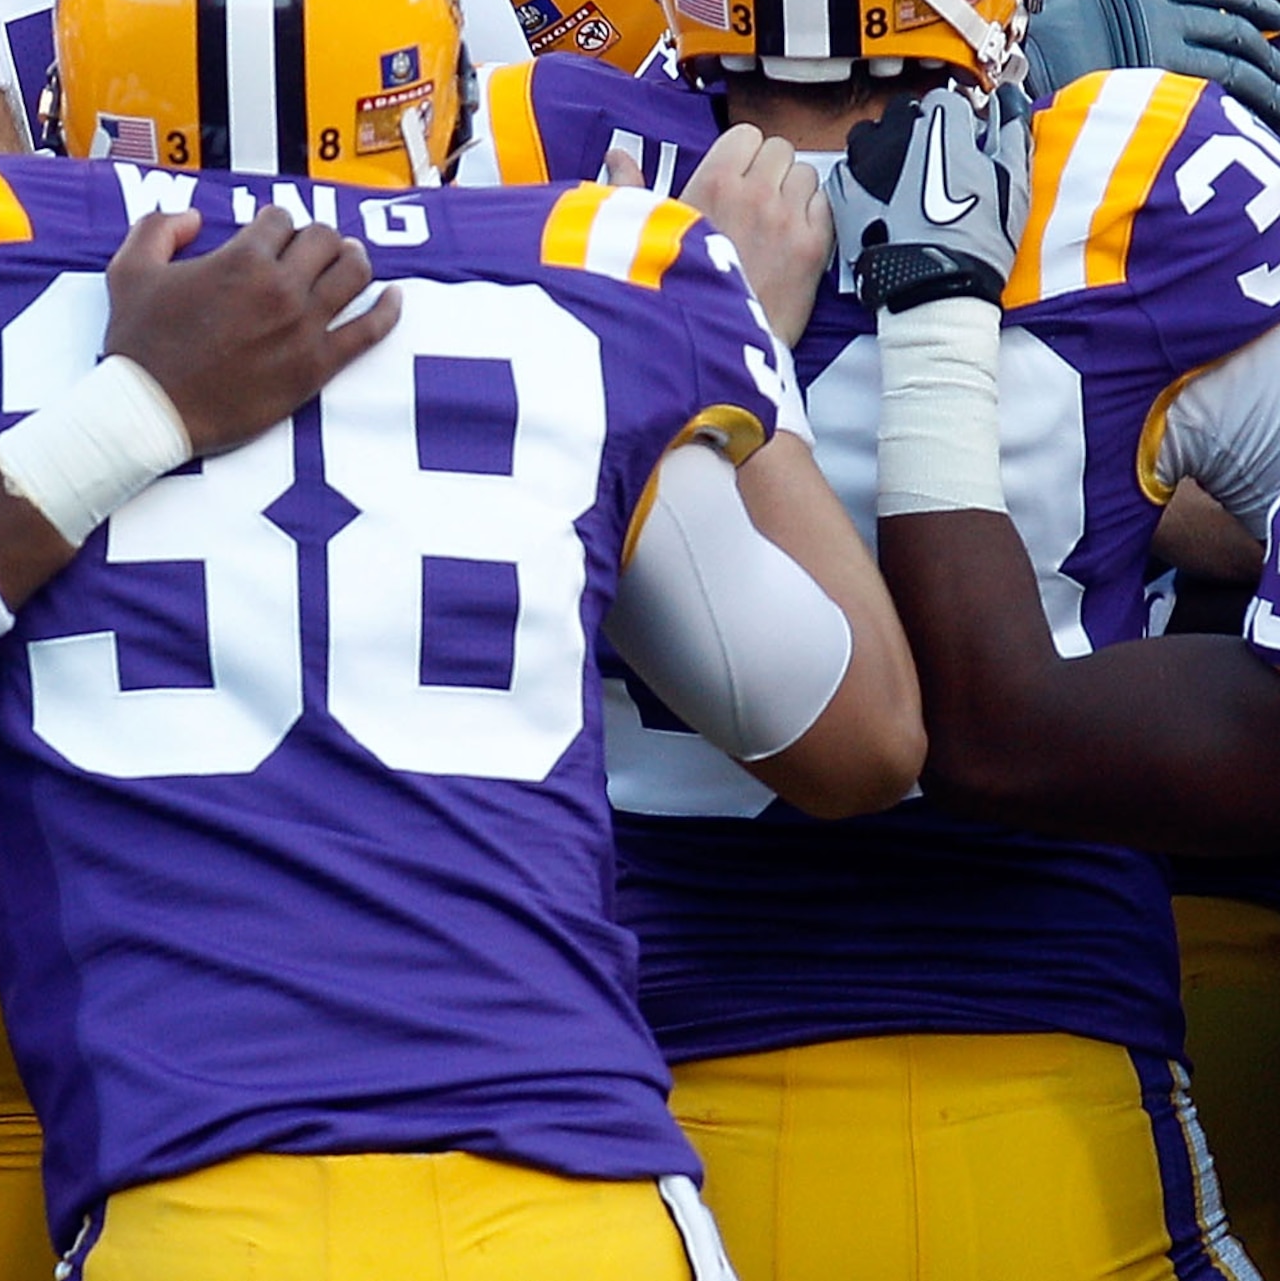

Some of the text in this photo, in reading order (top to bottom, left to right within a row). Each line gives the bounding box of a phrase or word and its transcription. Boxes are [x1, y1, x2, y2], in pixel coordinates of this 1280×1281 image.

[730, 2, 754, 37] 3
[865, 6, 888, 39] 8
[166, 130, 189, 165] 3
[319, 128, 341, 161] 8
[2, 271, 607, 782] 38
